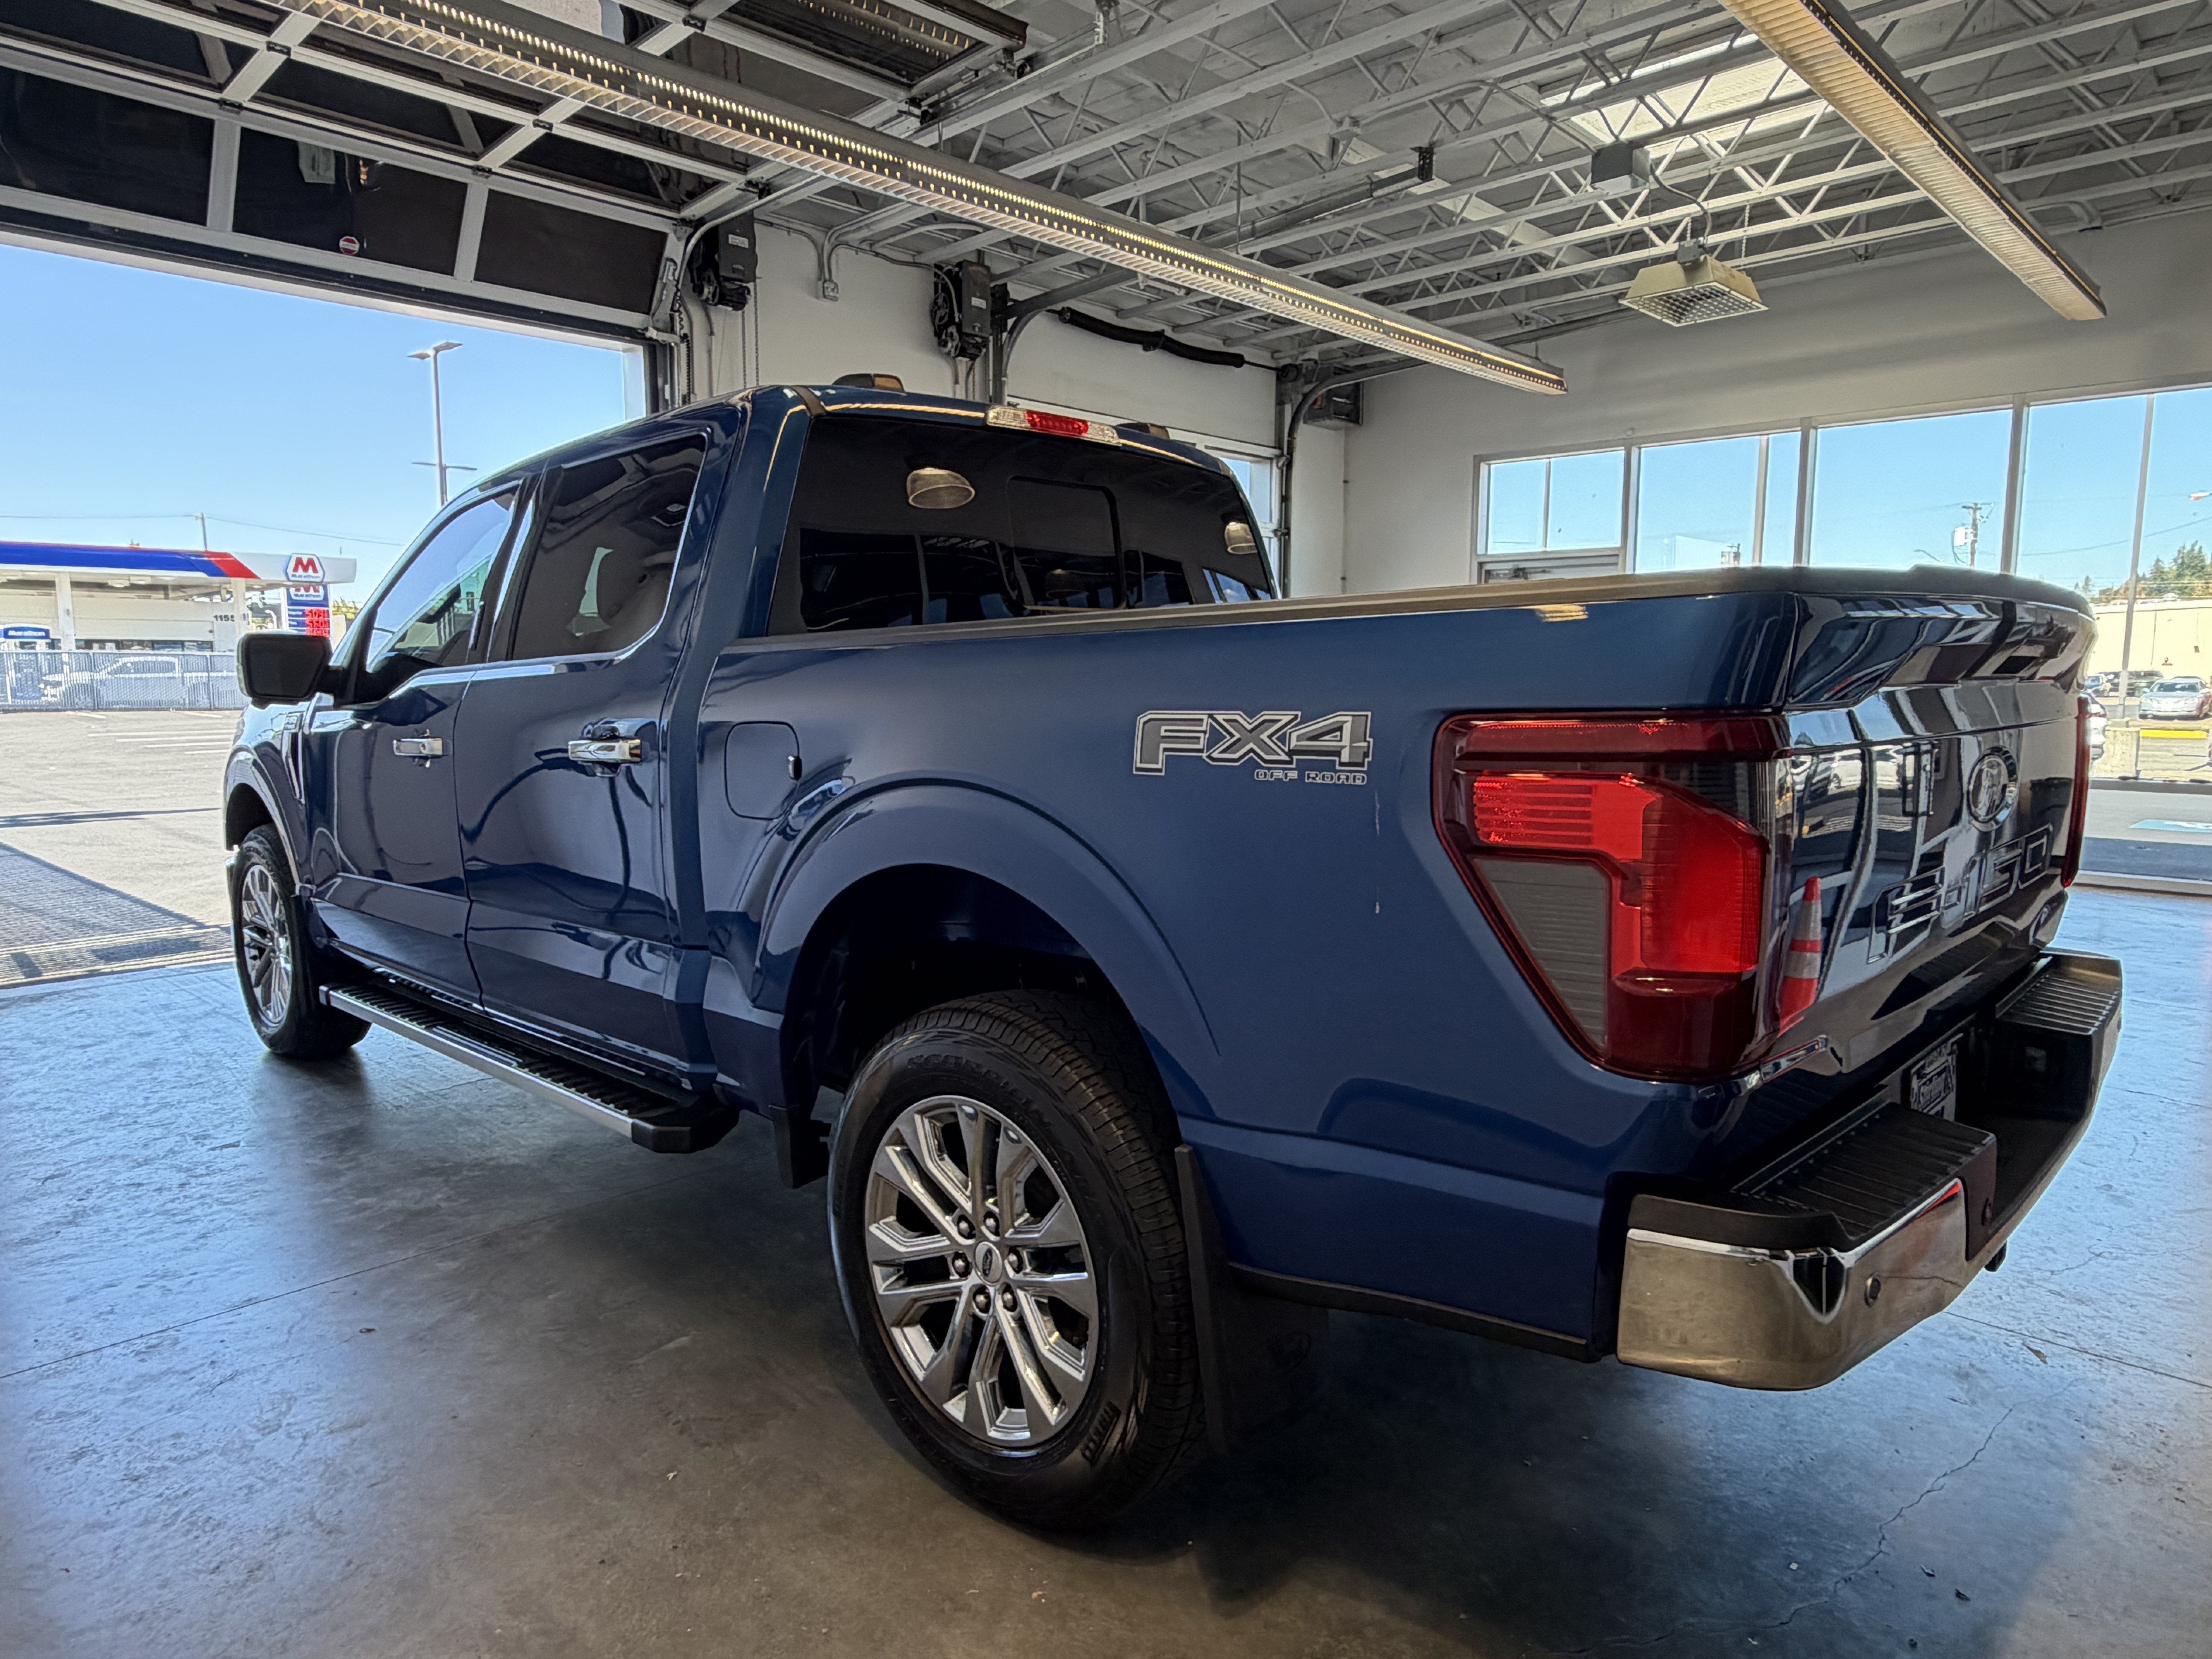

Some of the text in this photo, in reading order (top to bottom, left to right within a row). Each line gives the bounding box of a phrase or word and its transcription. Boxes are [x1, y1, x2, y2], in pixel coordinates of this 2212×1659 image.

[292, 557, 319, 574] M
[1133, 710, 1372, 775] FX4
[1254, 769, 1367, 785] OFF ROAD
